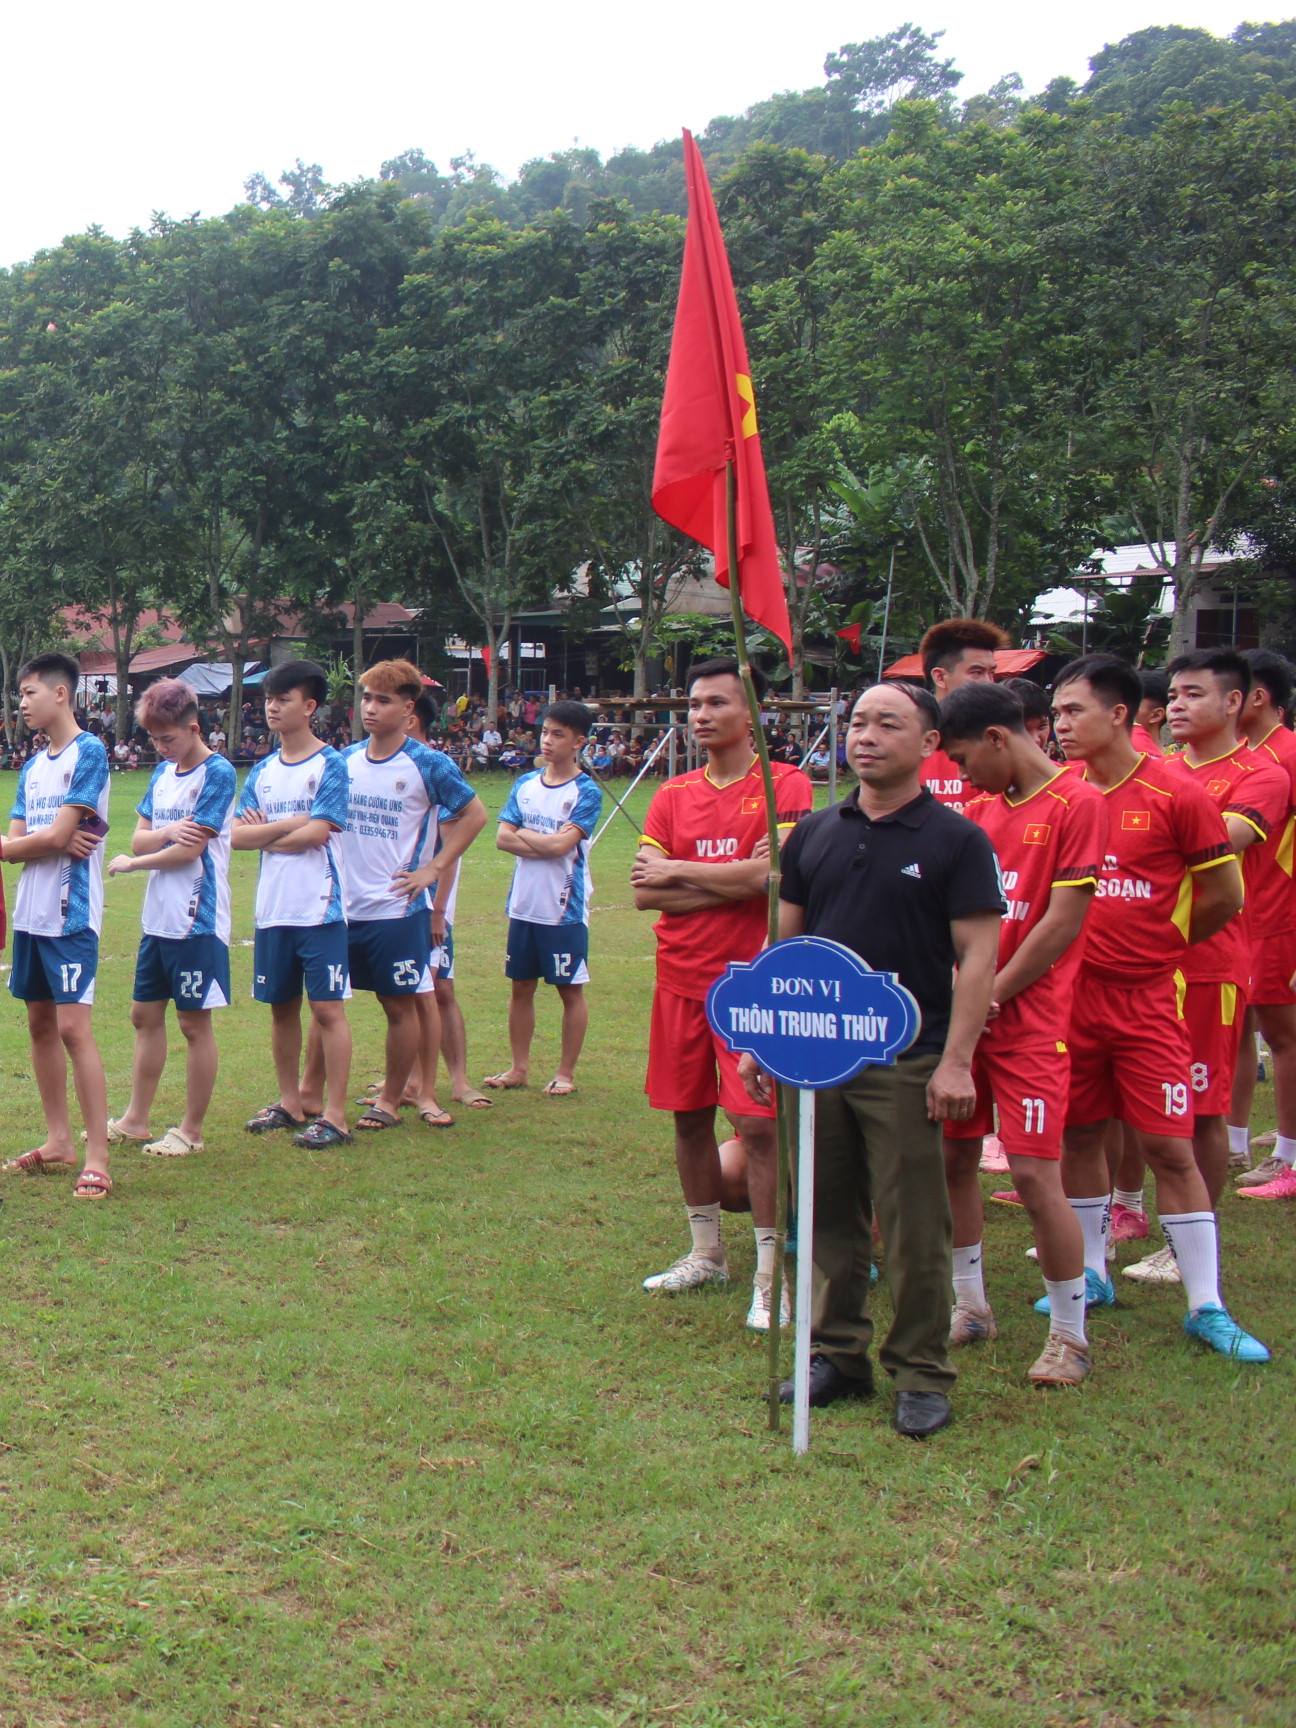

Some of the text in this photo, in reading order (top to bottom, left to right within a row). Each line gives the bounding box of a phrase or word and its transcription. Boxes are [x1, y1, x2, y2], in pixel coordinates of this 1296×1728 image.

[926, 779, 963, 795] VLXD
[695, 838, 738, 858] VLXD
[1095, 878, 1151, 901] SOẠN
[60, 963, 82, 992] 17
[327, 963, 344, 992] 14
[393, 959, 420, 986] 25
[552, 952, 572, 977] 12
[180, 970, 203, 998] 22
[771, 977, 841, 1002] ĐƠN VỊ
[729, 1003, 888, 1042] THÔN TRUNG THỦY
[1161, 1082, 1188, 1117] 19
[1022, 1097, 1045, 1135] 11
